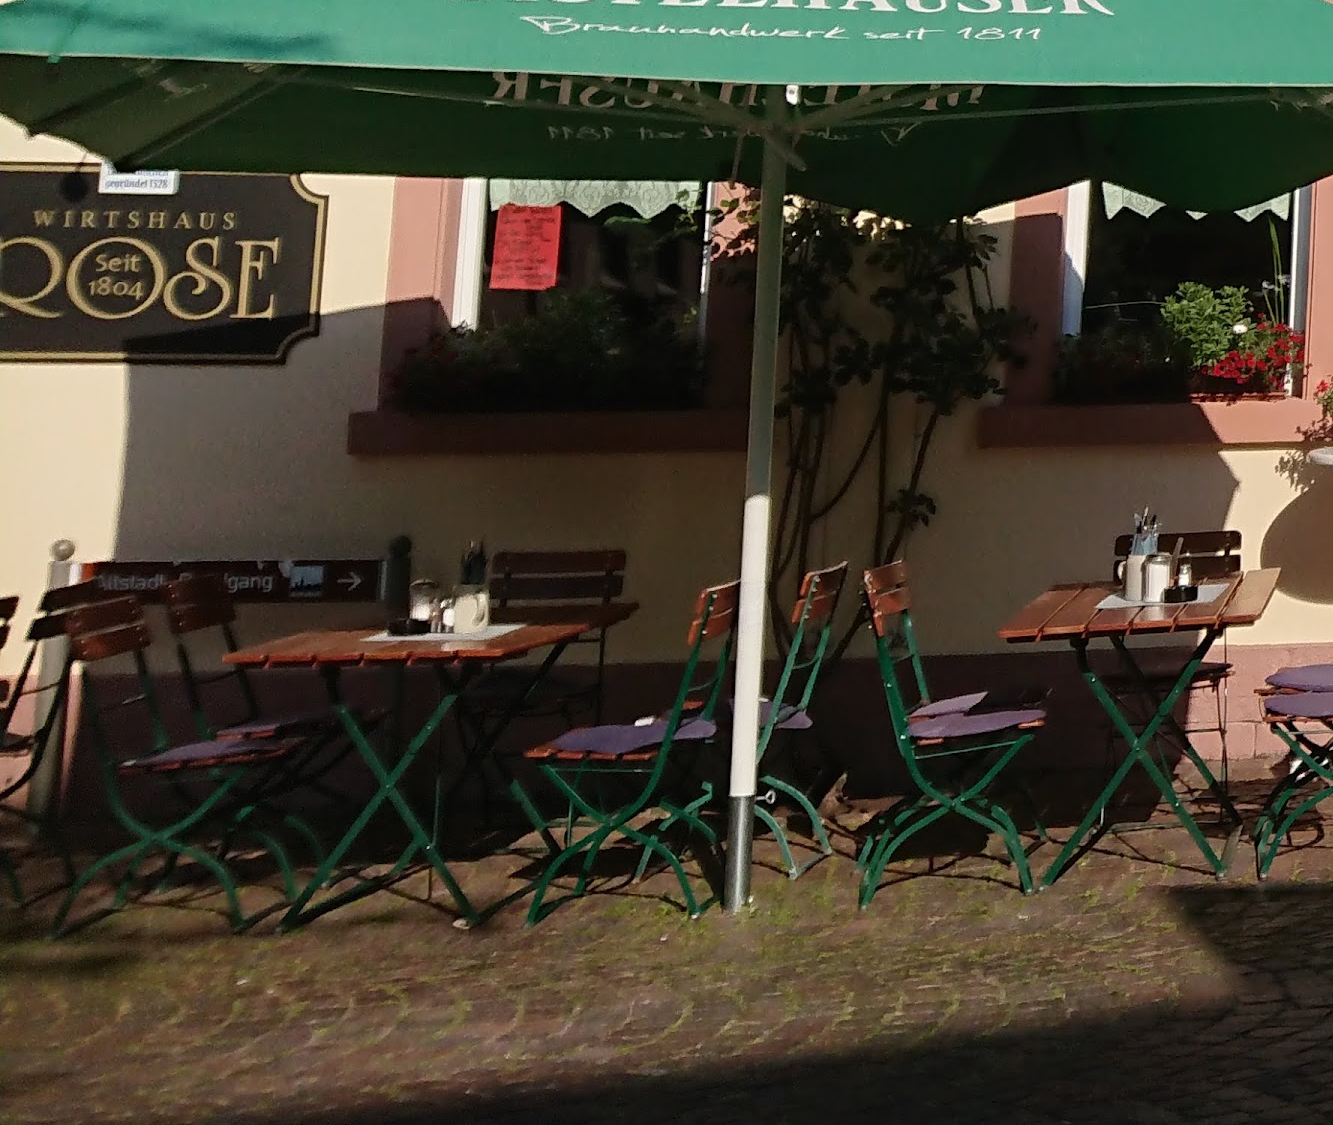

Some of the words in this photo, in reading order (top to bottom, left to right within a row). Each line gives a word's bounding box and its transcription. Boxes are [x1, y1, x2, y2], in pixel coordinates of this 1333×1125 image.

[519, 16, 850, 40] Brauhandwerk
[863, 27, 945, 40] seit
[956, 26, 1041, 40] 1811
[33, 210, 237, 230] WIRTSHAUS
[95, 254, 141, 273] Seit
[88, 278, 144, 300] 1804
